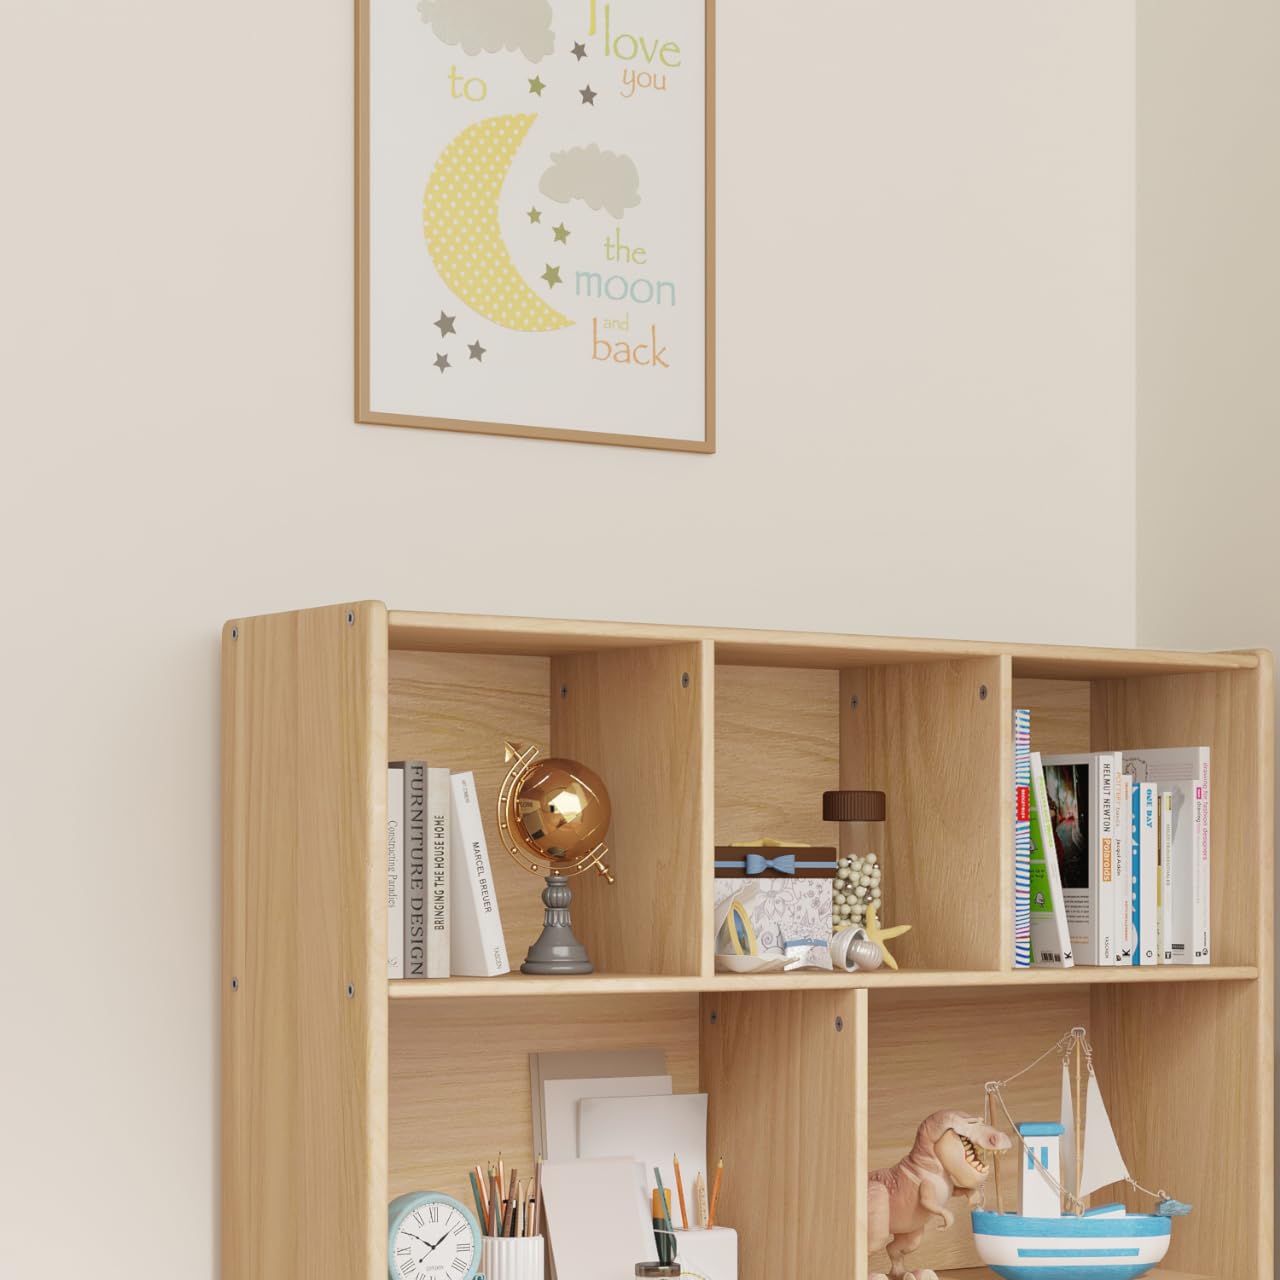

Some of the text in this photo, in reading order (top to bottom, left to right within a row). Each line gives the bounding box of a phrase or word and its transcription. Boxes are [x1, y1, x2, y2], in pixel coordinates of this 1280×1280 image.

[604, 3, 682, 68] love
[448, 65, 488, 102] to
[620, 68, 667, 98] you
[603, 226, 648, 265] the
[574, 269, 677, 306] moon
[591, 316, 670, 369] back
[602, 312, 630, 332] and
[1103, 763, 1111, 832] HELMUT NEWTON
[1103, 839, 1112, 881] Polaroids
[1201, 828, 1209, 861] designers
[411, 765, 425, 976] FURNITURE DESIGN
[434, 815, 445, 930] BRINGING THE HOUSE HOME
[472, 841, 492, 913] MARCEL BREUER
